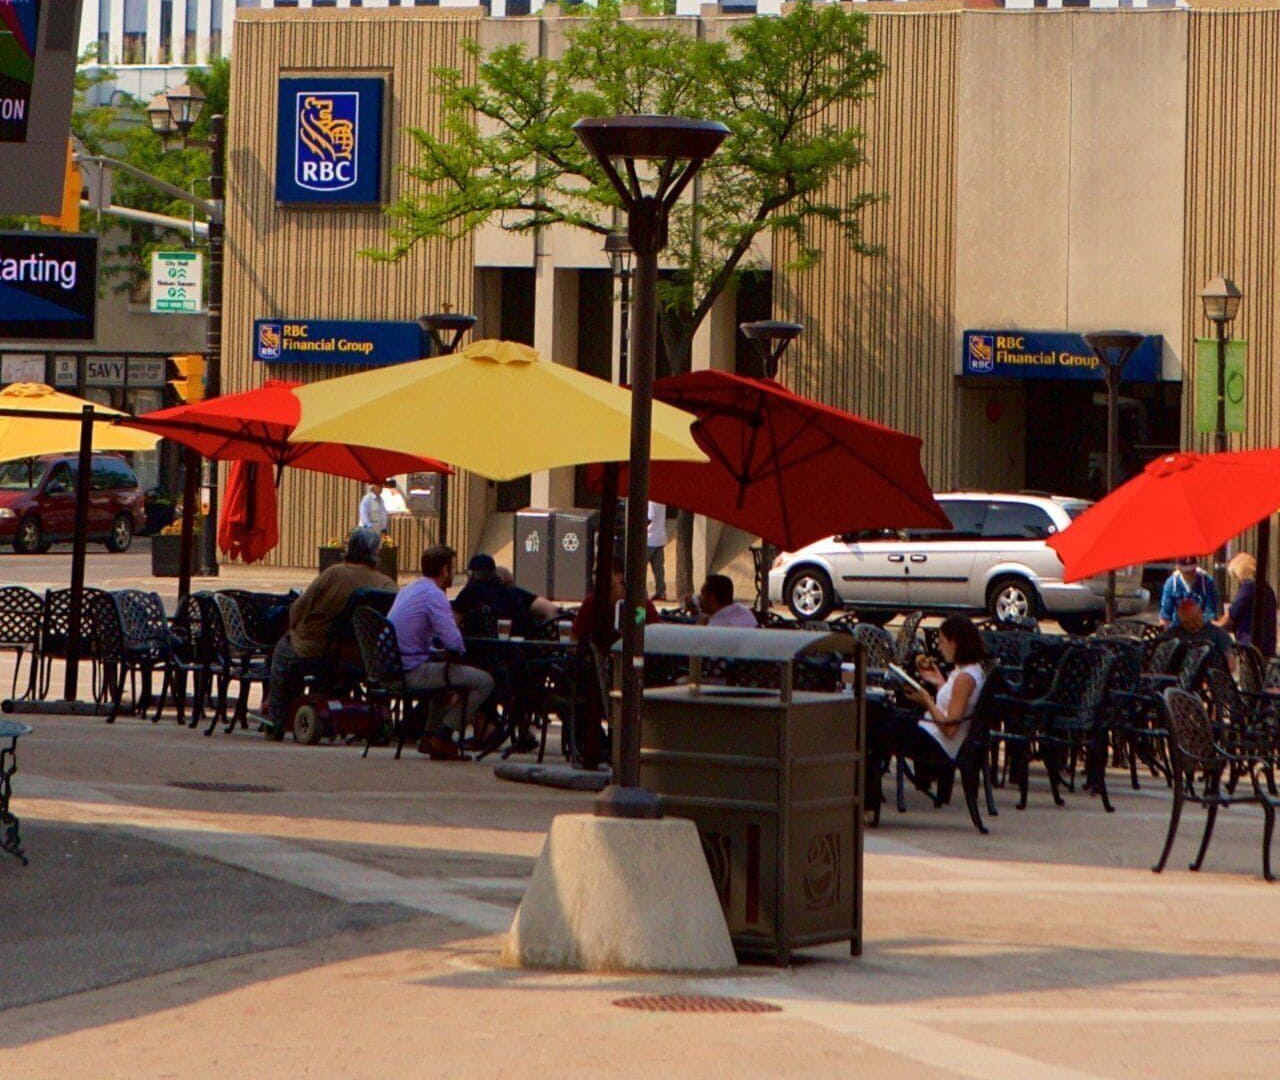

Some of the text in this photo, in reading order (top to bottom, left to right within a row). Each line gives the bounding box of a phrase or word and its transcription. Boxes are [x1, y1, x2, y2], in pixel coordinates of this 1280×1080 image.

[303, 161, 351, 182] RBC
[283, 324, 308, 337] RBC
[283, 338, 374, 355] Financial Group
[996, 336, 1025, 350] RBC
[261, 347, 278, 356] RBC
[972, 360, 991, 369] RBC
[996, 350, 1099, 369] Financial Group
[88, 362, 125, 379] SAVY
